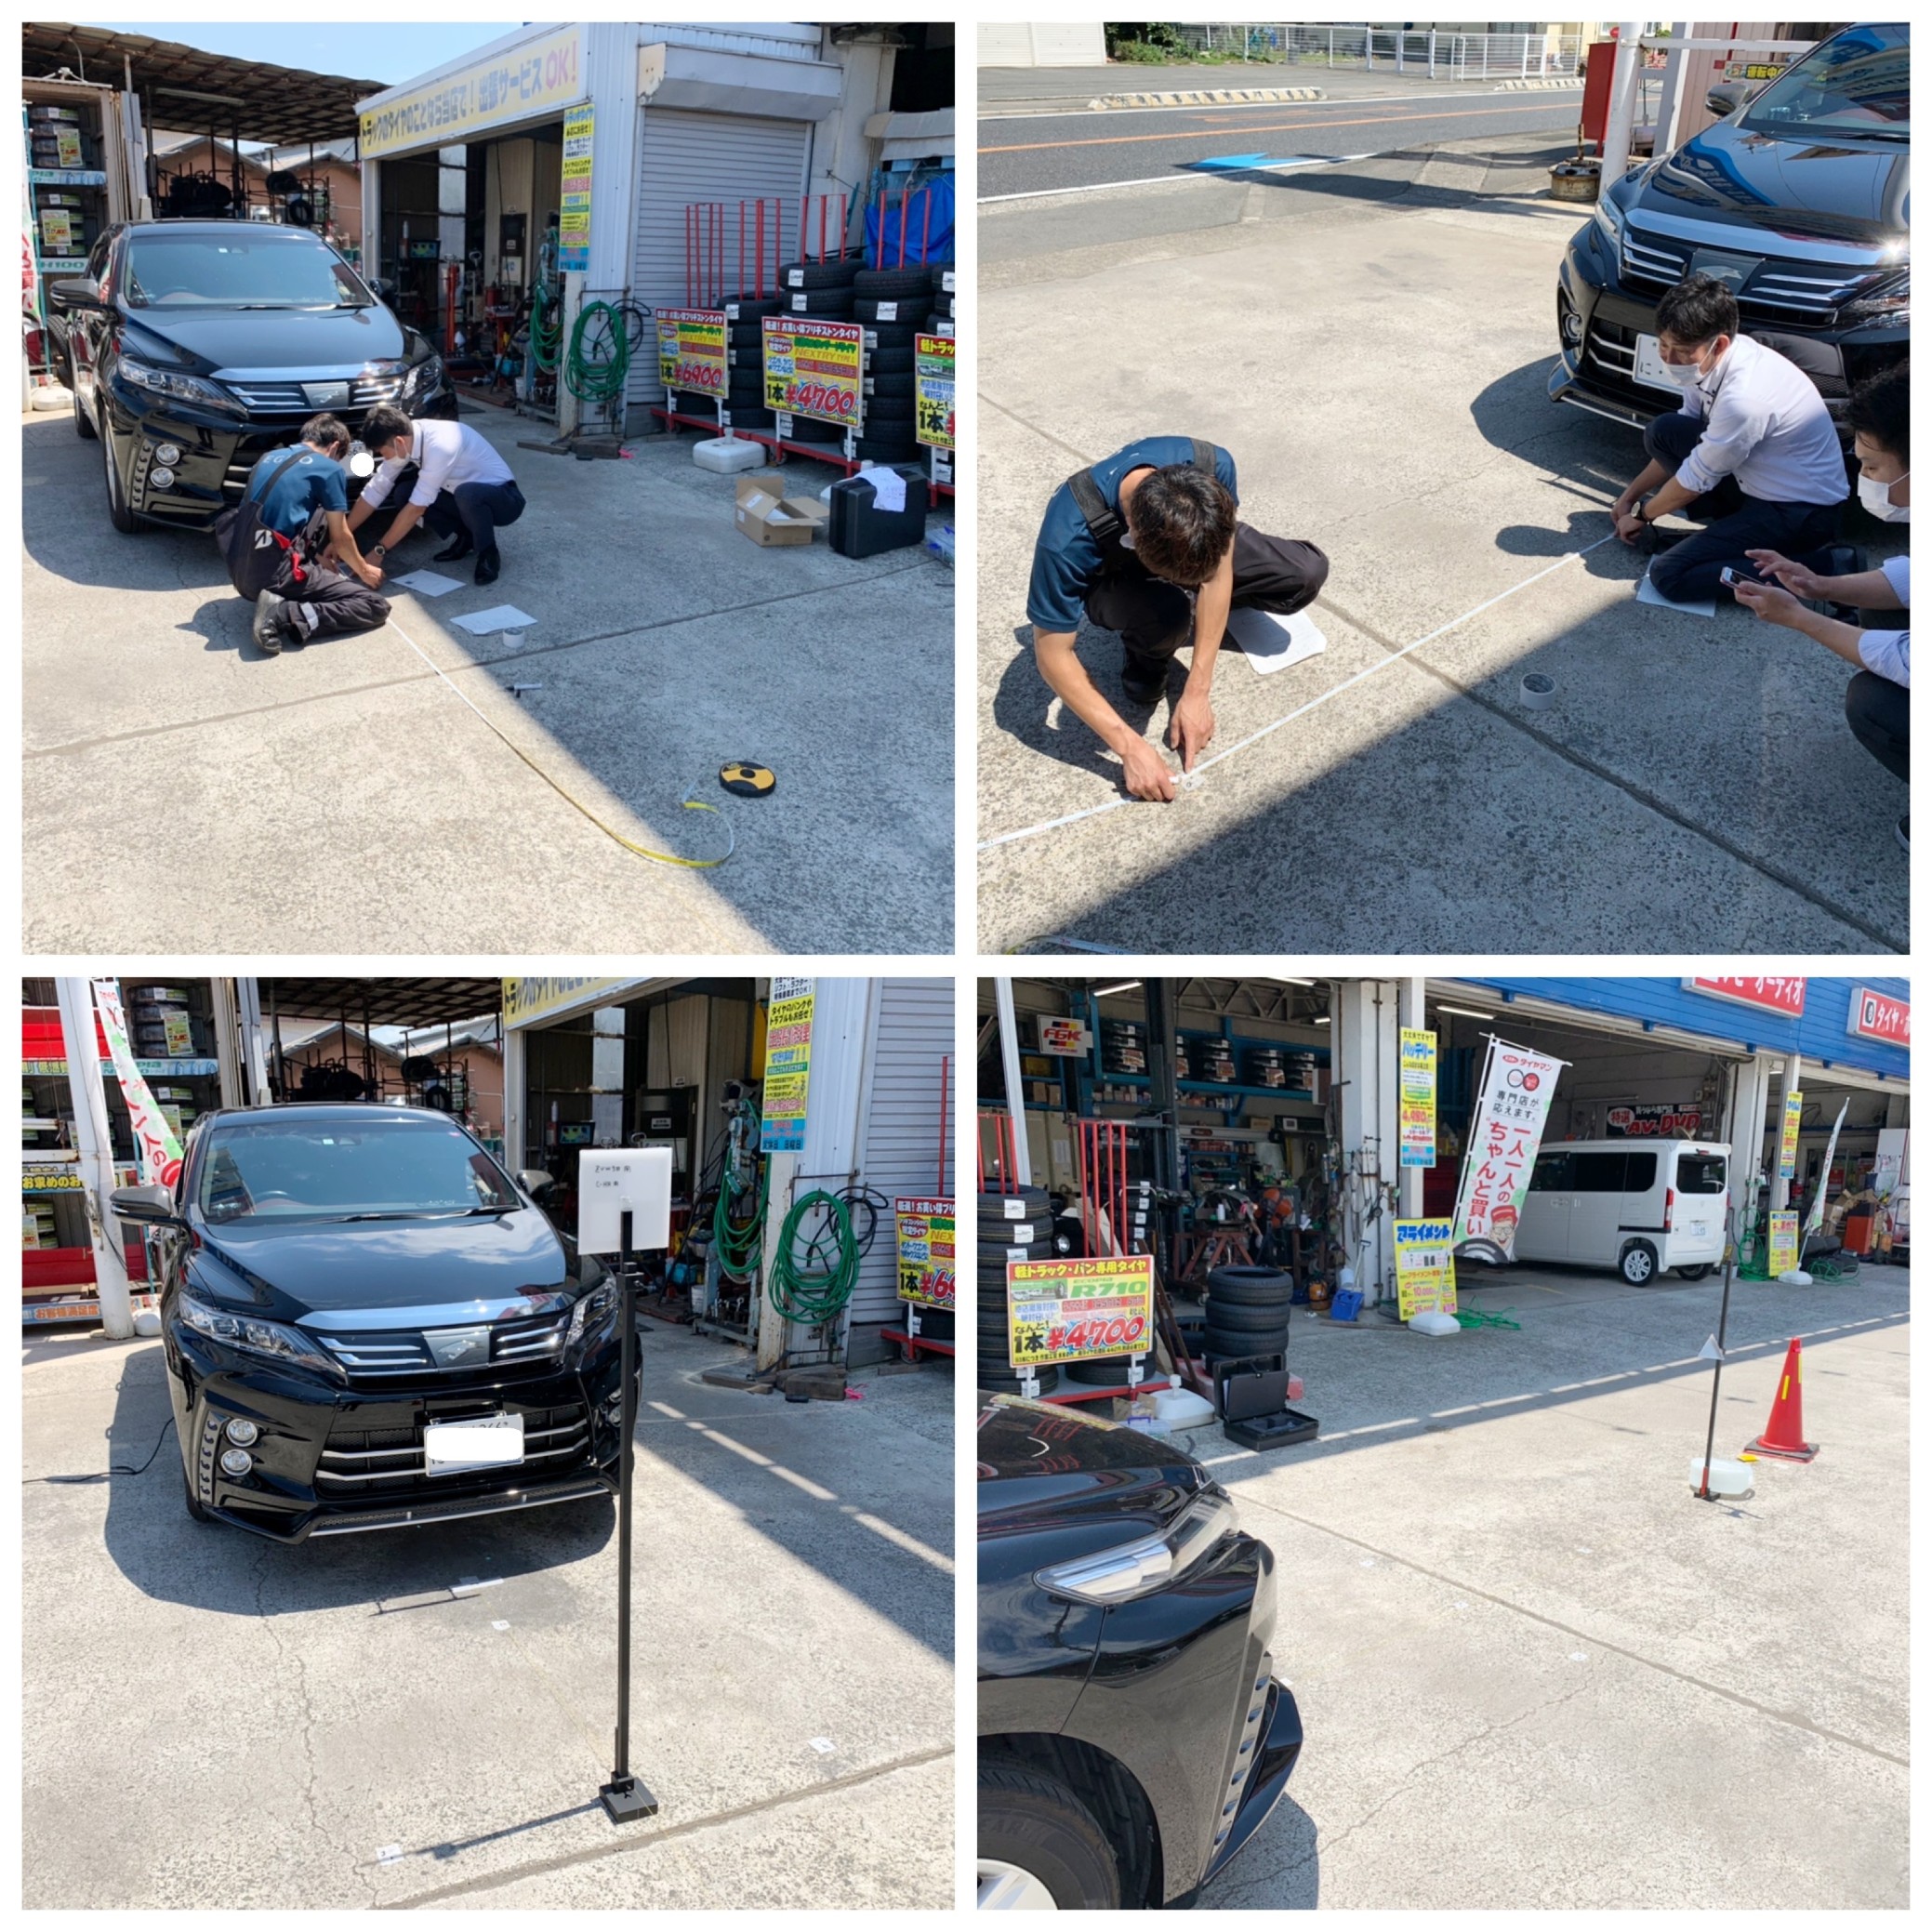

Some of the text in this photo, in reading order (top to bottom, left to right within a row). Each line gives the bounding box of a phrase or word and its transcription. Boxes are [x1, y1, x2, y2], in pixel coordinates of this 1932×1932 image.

[795, 348, 836, 361] NEXTRY
[675, 363, 722, 388] ¥6900
[767, 383, 784, 403] 1本
[785, 382, 855, 417] ¥4700
[920, 410, 944, 433] 1本
[1519, 1058, 1553, 1072] タイヤマン
[1497, 1090, 1540, 1107] 専門店が
[1493, 1103, 1535, 1120] 応えます。
[1497, 1127, 1531, 1203] 一人一人の
[22, 1175, 84, 1189] お求めのお
[1014, 1259, 1146, 1279] 軽トラック・バン専用タイヤ
[900, 1271, 919, 1293] 1本
[1070, 1280, 1147, 1299] R710
[1014, 1320, 1049, 1333] なんと!
[1014, 1316, 1145, 1354] 1本 ¥4700
